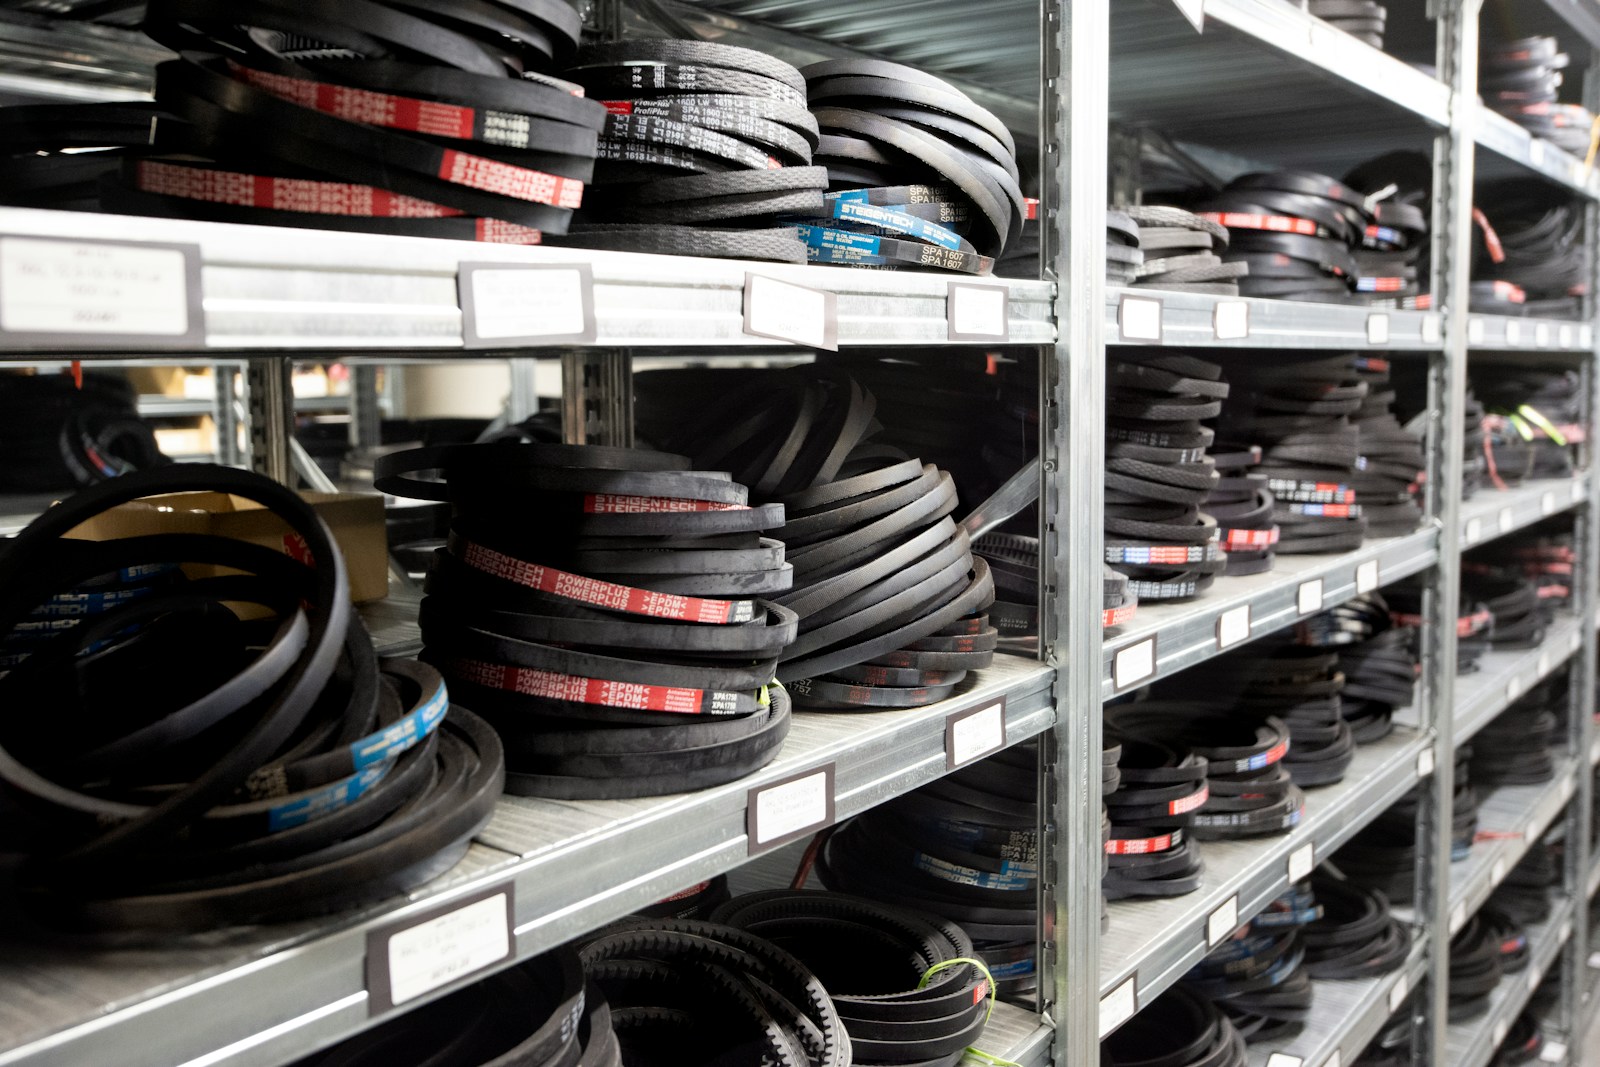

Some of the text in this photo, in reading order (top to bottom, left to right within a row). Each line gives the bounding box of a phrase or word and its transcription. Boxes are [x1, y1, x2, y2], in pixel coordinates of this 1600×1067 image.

[634, 107, 670, 116] ProfiPlus
[682, 106, 700, 115] SPA
[682, 114, 700, 123] SPA
[624, 152, 644, 160] 1618
[910, 188, 930, 196] SPA
[910, 196, 930, 204] SPA
[842, 204, 914, 228] STEIGENTECH
[940, 208, 956, 216] SPA
[922, 245, 964, 260] SPA 1607
[920, 254, 962, 269] SPA 1607
[594, 494, 697, 511] STEIGENTECH
[468, 540, 545, 576] STEIGENTECH
[466, 549, 542, 584] STEIGENTECH
[555, 582, 628, 608] POWERPLUS
[641, 604, 686, 618] >EPDM<
[557, 573, 630, 598] POWERPLUS
[643, 595, 688, 610] >EPDM<
[518, 668, 588, 686] POWERPLUS
[604, 682, 650, 694] >EPDM<
[516, 676, 648, 702] POWERPLUS >EPDM<
[1000, 850, 1020, 858] SPA
